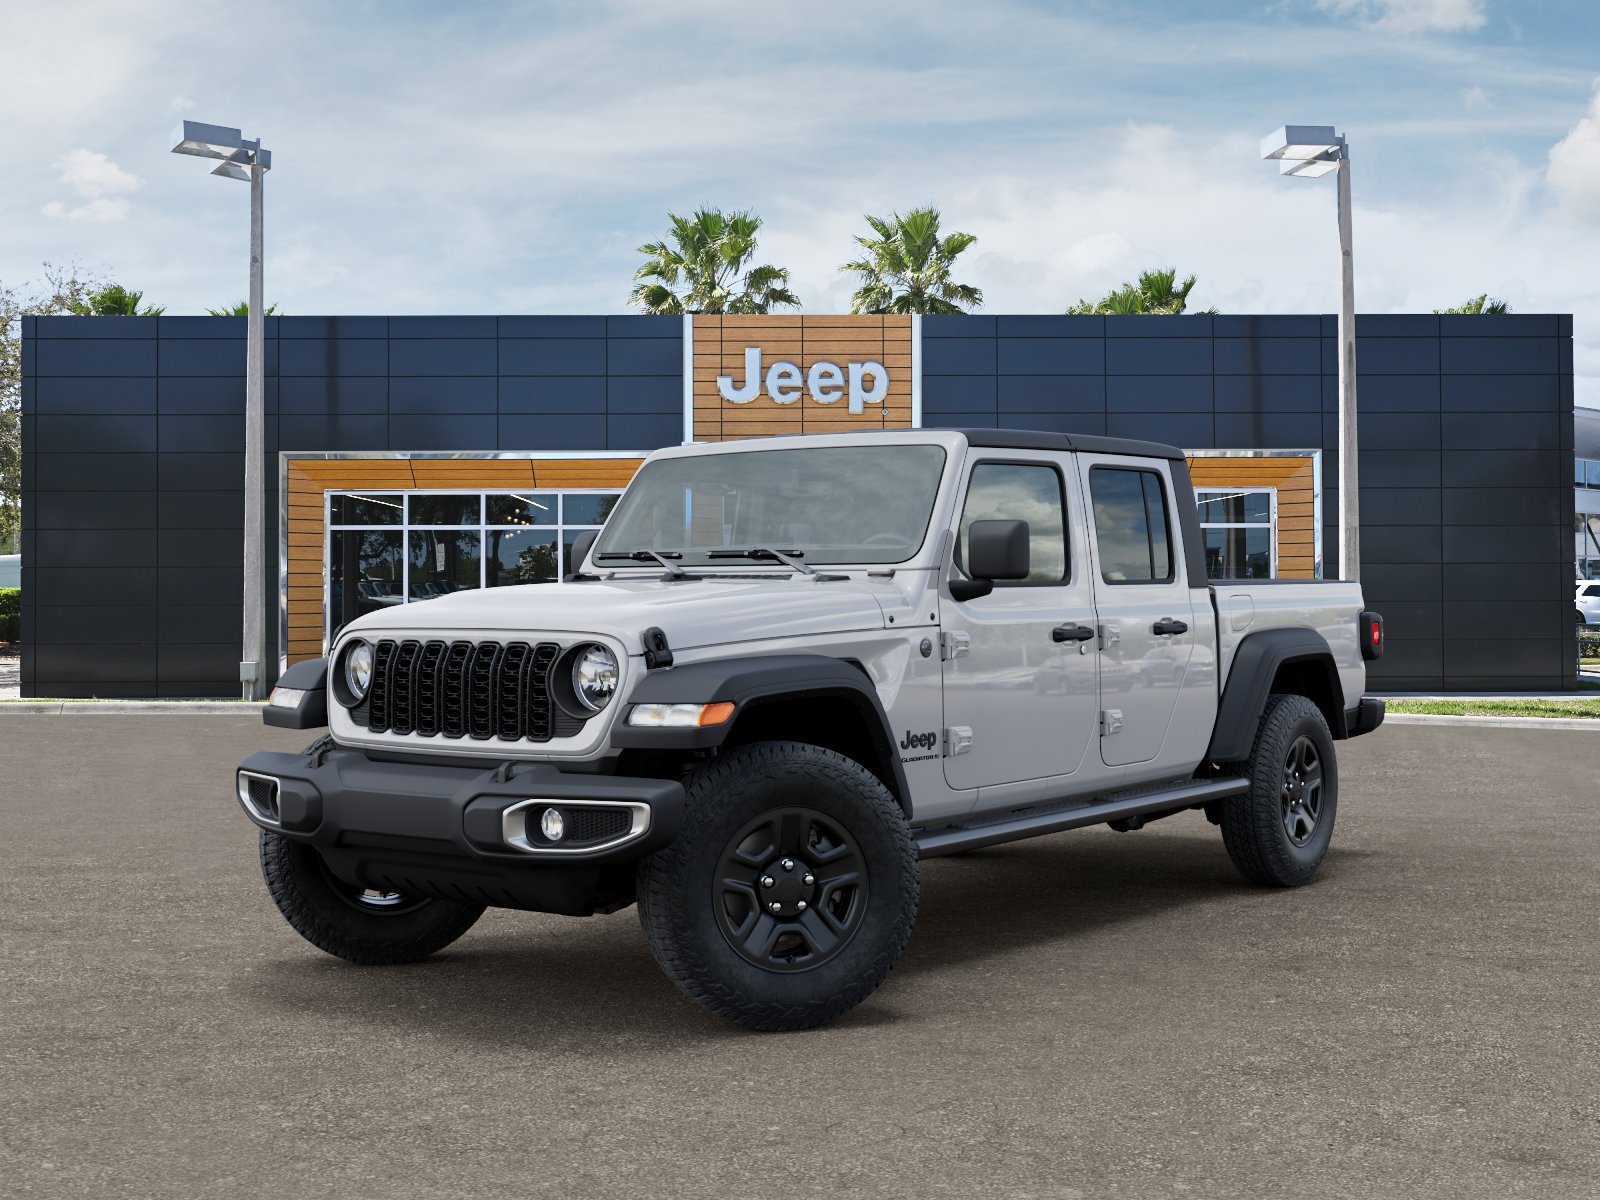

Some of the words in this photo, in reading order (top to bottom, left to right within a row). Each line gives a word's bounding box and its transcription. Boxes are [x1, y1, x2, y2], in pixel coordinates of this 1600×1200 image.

[716, 347, 890, 415] Jeep
[900, 730, 937, 751] Jeep
[901, 754, 934, 763] GLADIATOR
